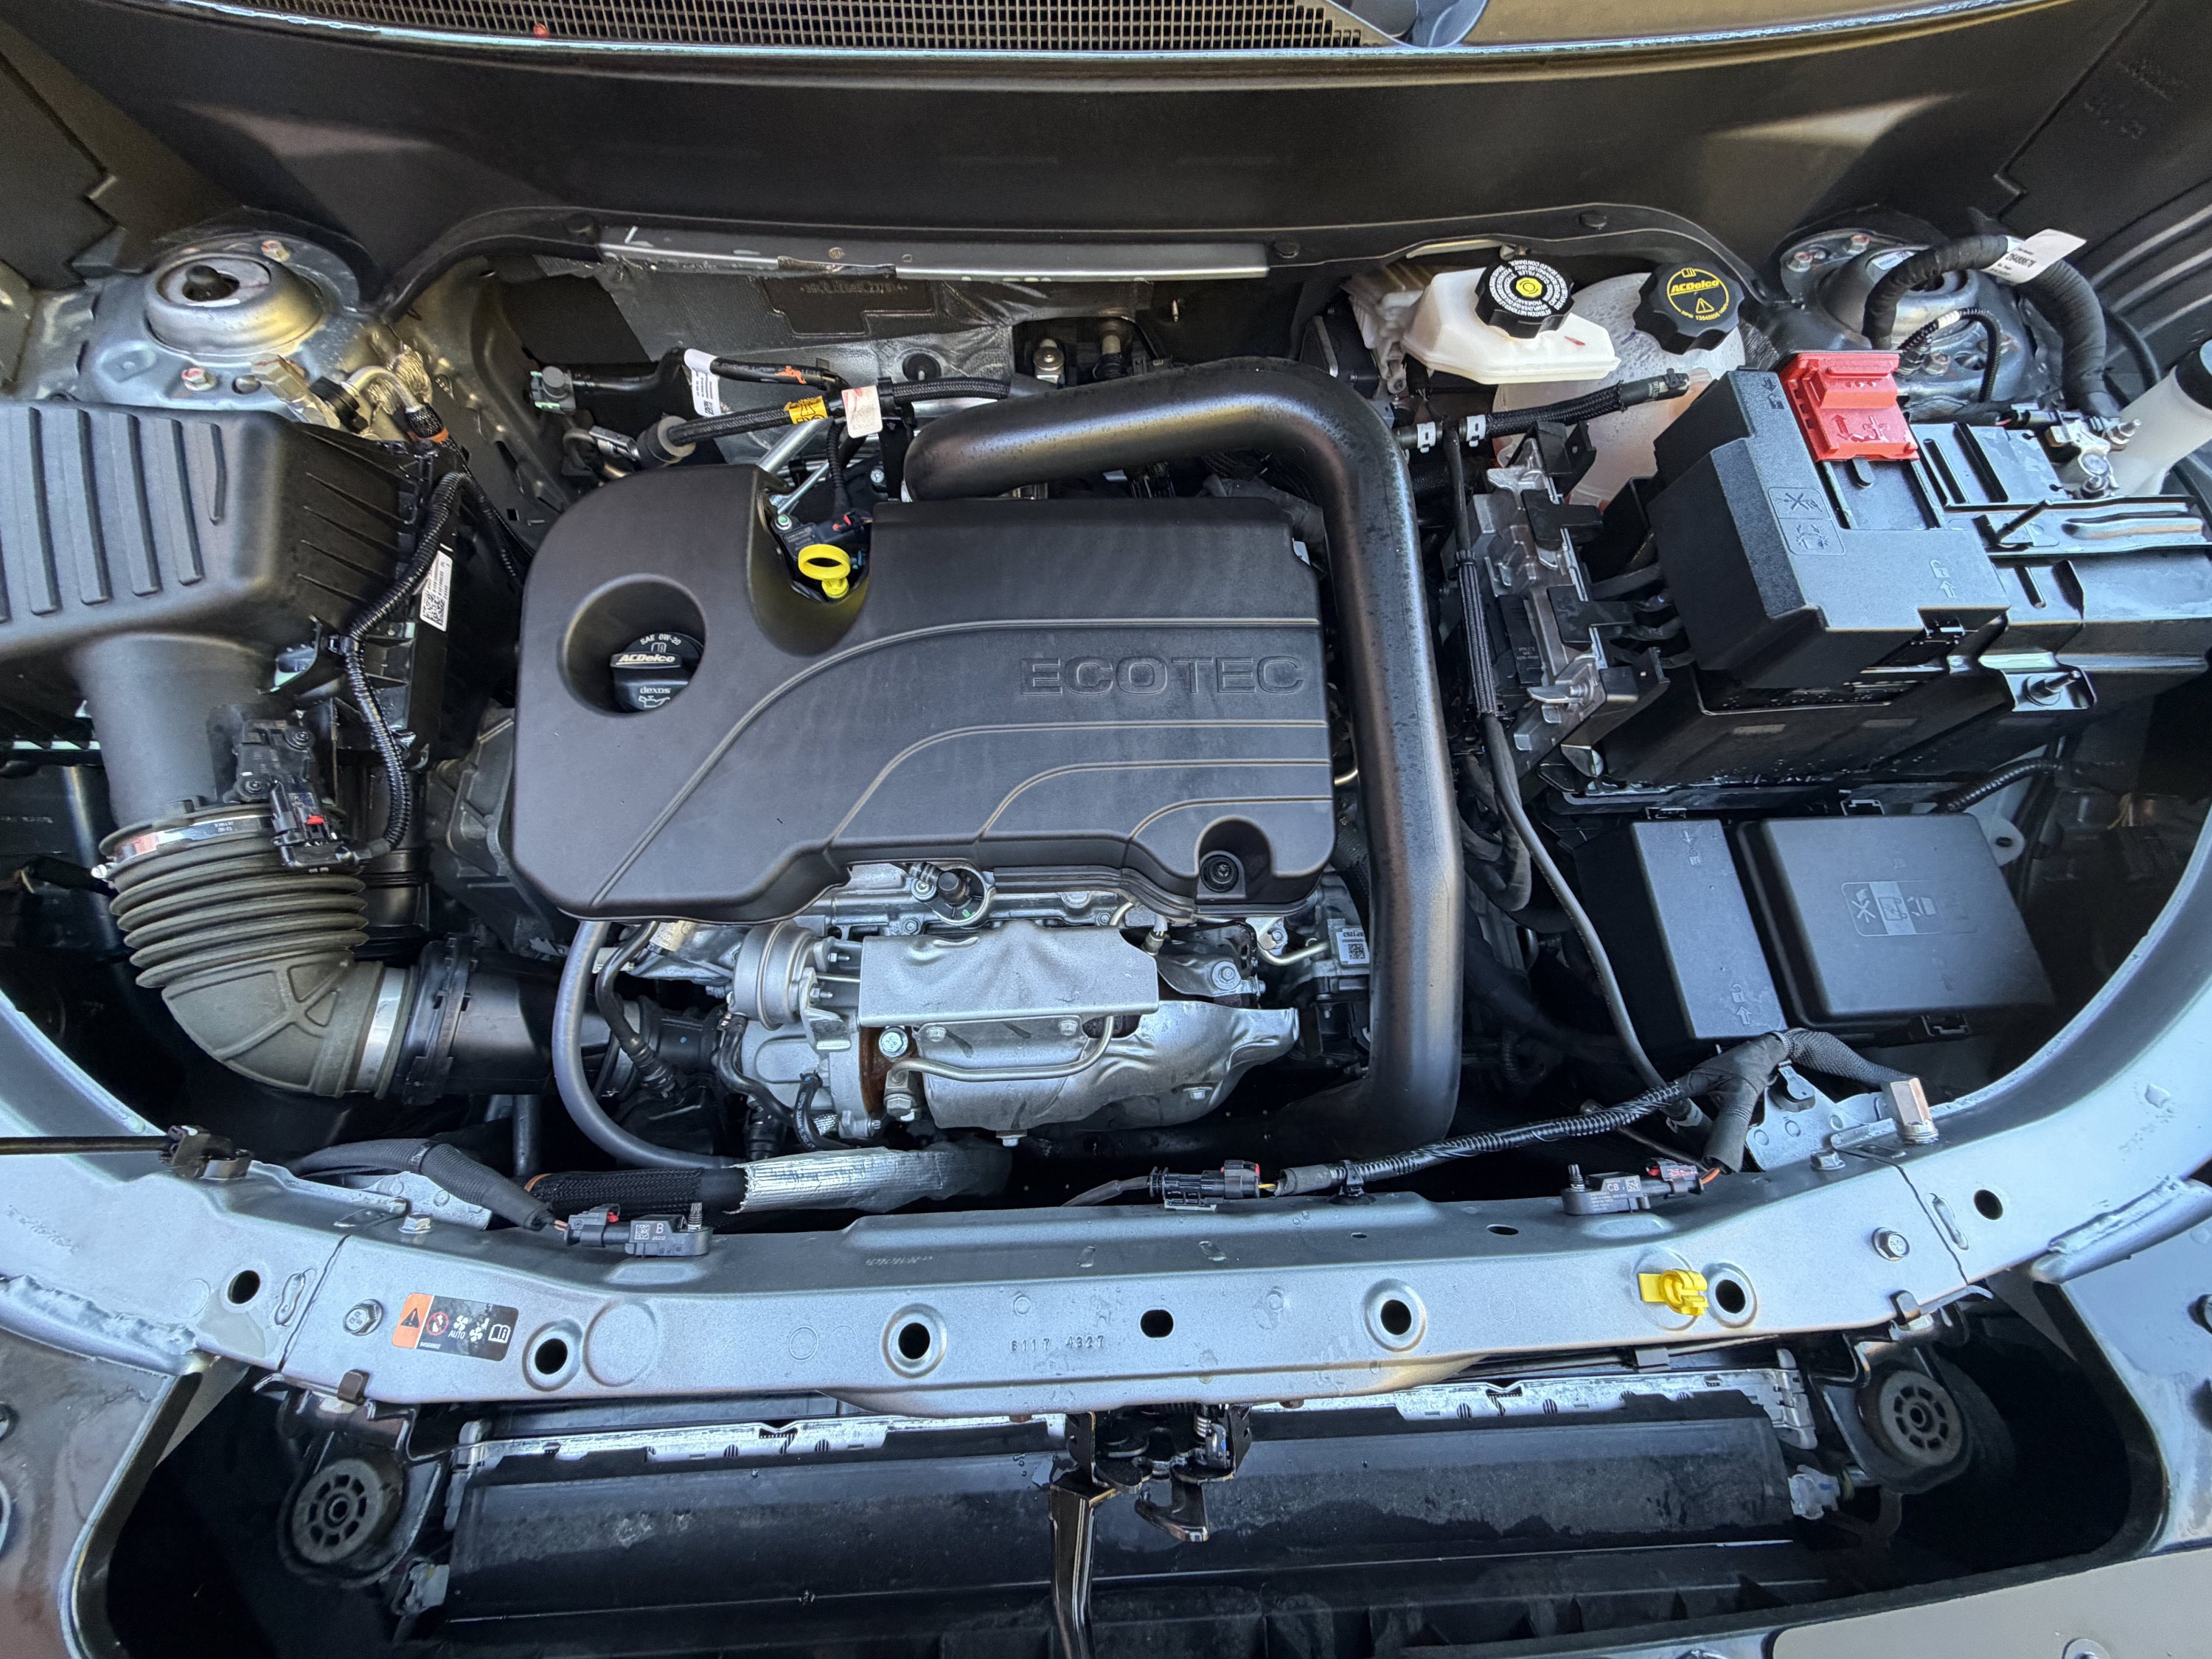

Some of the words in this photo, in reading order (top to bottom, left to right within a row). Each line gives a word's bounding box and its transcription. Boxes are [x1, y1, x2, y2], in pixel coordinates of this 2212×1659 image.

[1671, 280, 1719, 293] ACDelco
[640, 634, 655, 645] SAE
[658, 633, 681, 646] 0W-20
[618, 654, 676, 663] ACDelco
[1020, 655, 1304, 696] ECOTEC
[1607, 1183, 1620, 1192] CB
[656, 1222, 664, 1234] B
[448, 1330, 466, 1340] AUTO
[1066, 1335, 1104, 1349] 4327
